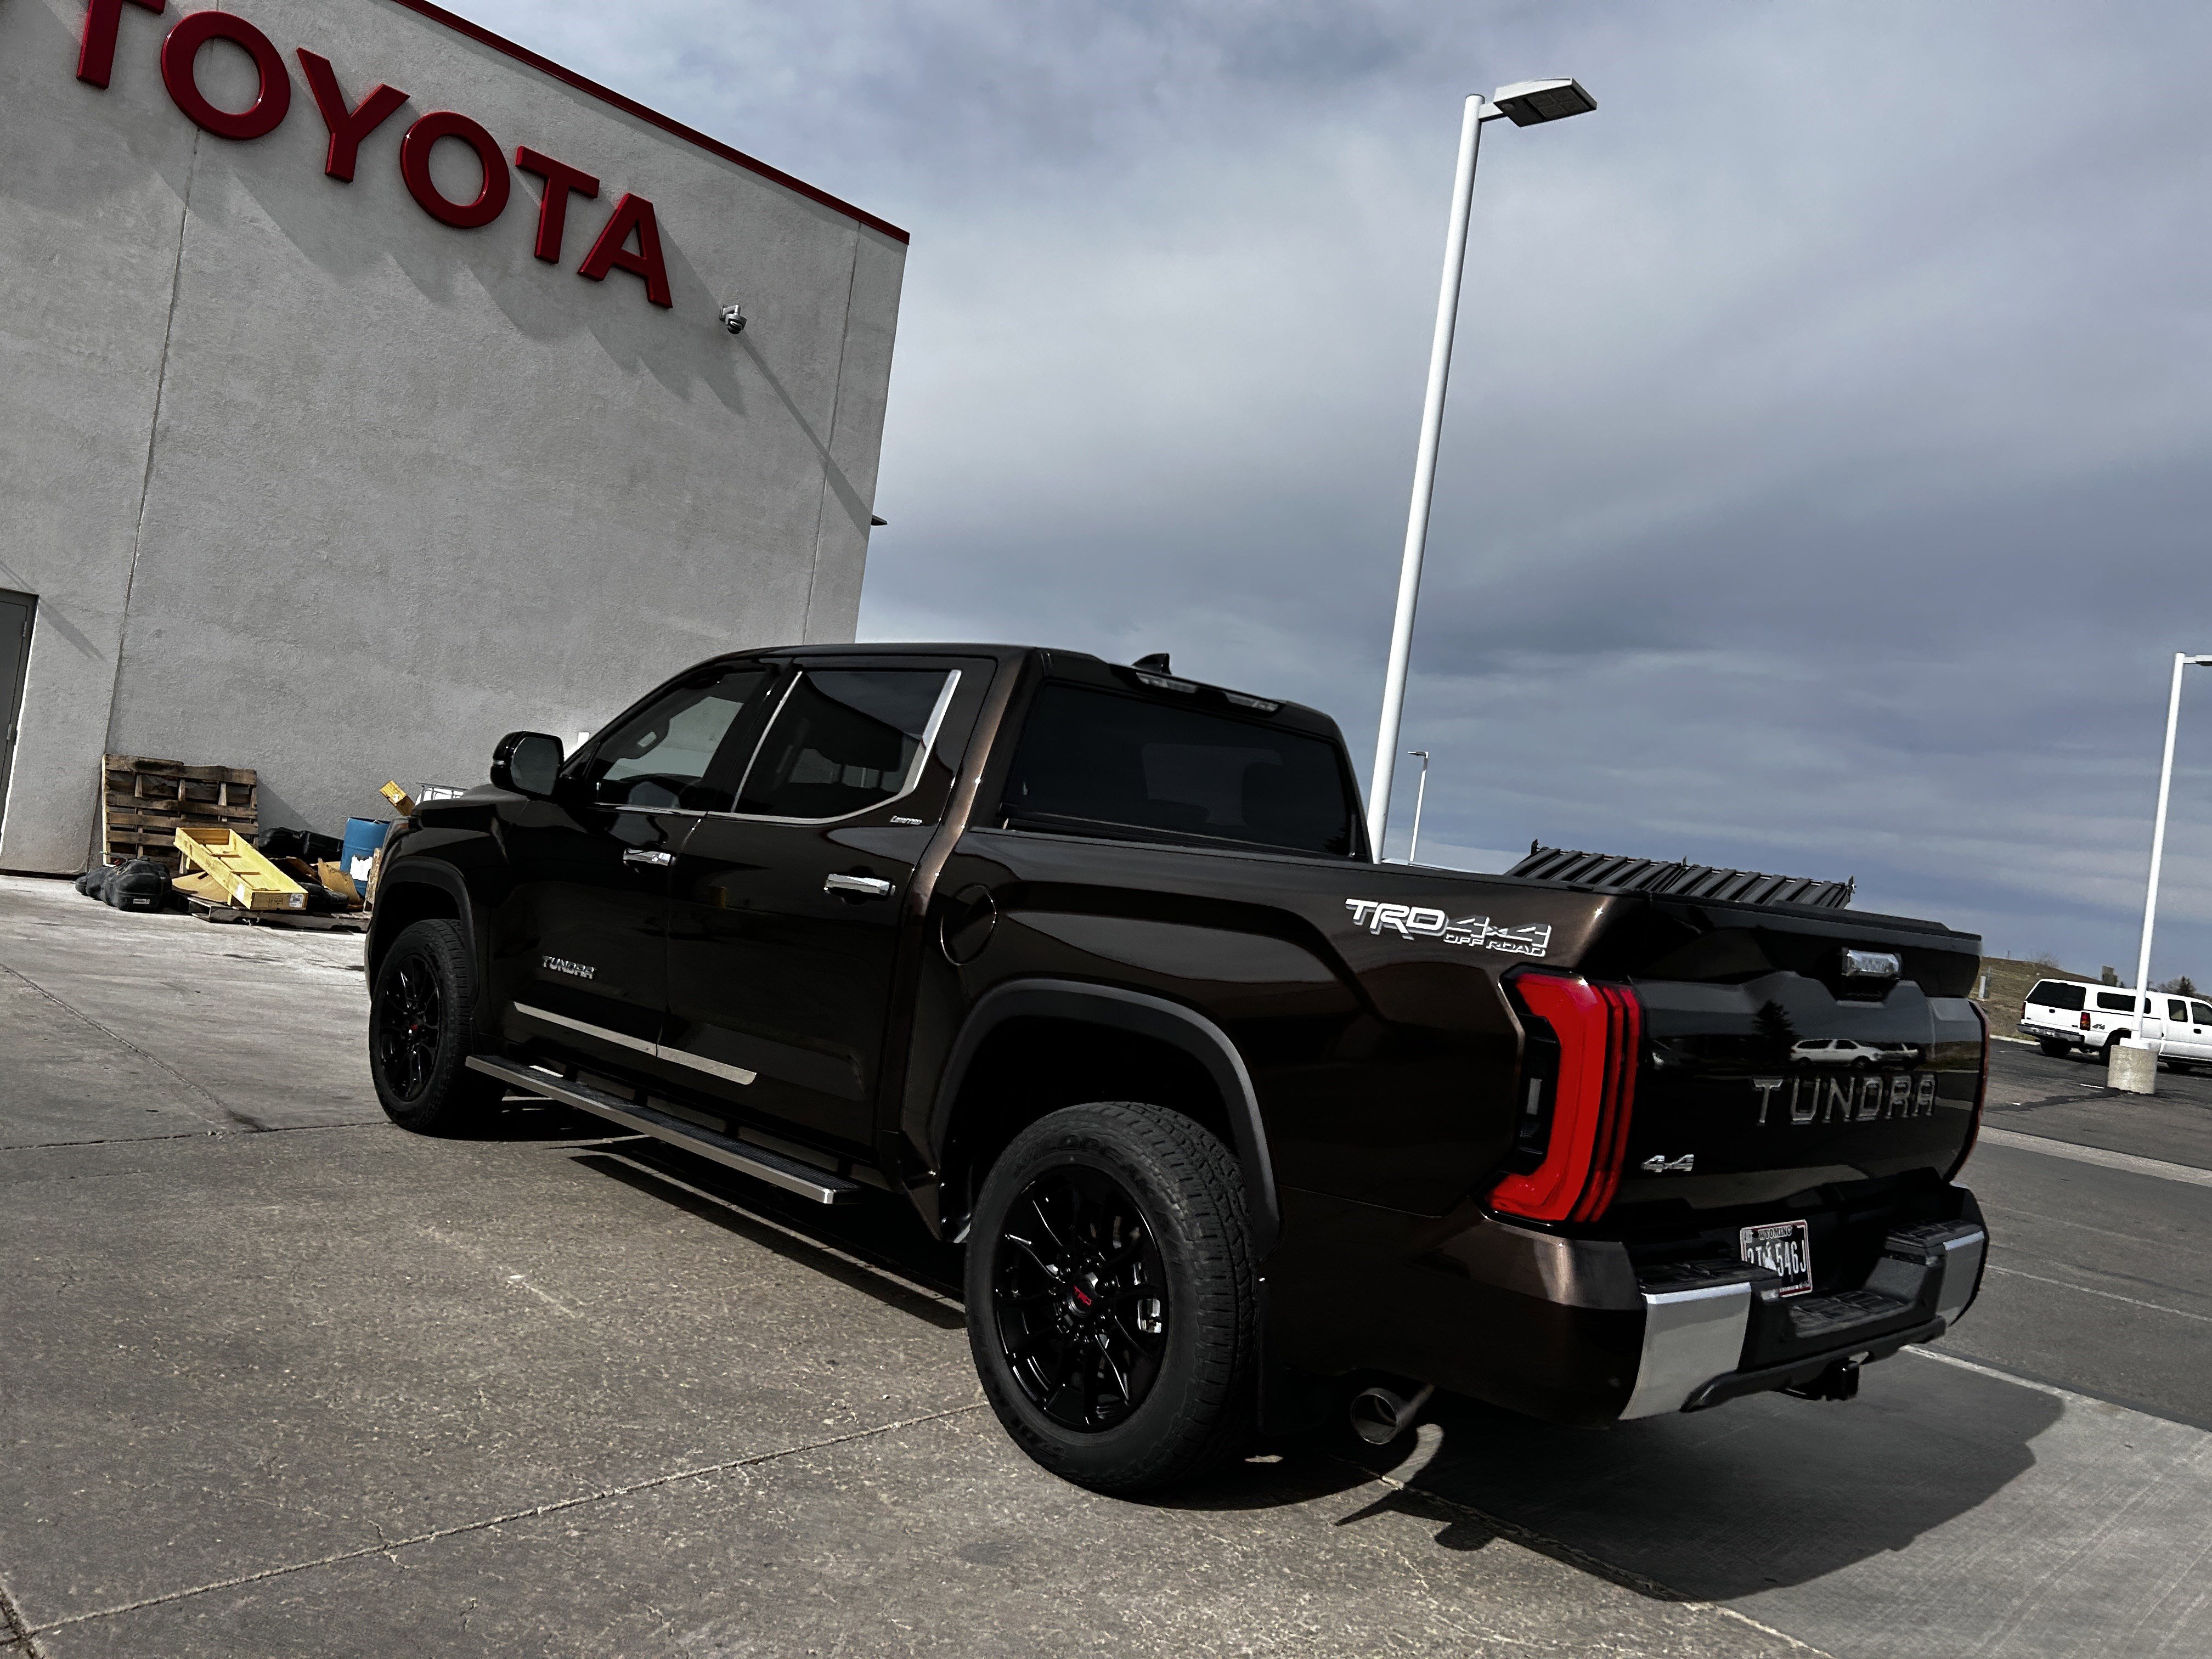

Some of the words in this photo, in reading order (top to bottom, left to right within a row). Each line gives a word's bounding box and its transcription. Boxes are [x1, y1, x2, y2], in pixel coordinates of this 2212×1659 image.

[1345, 899, 1449, 940] TRD
[1443, 933, 1483, 947] OFF
[1486, 940, 1546, 957] ROAD
[541, 955, 594, 979] TUNDRA
[1753, 1074, 1937, 1125] TUNDRA
[1759, 1225, 1792, 1240] WYOMING
